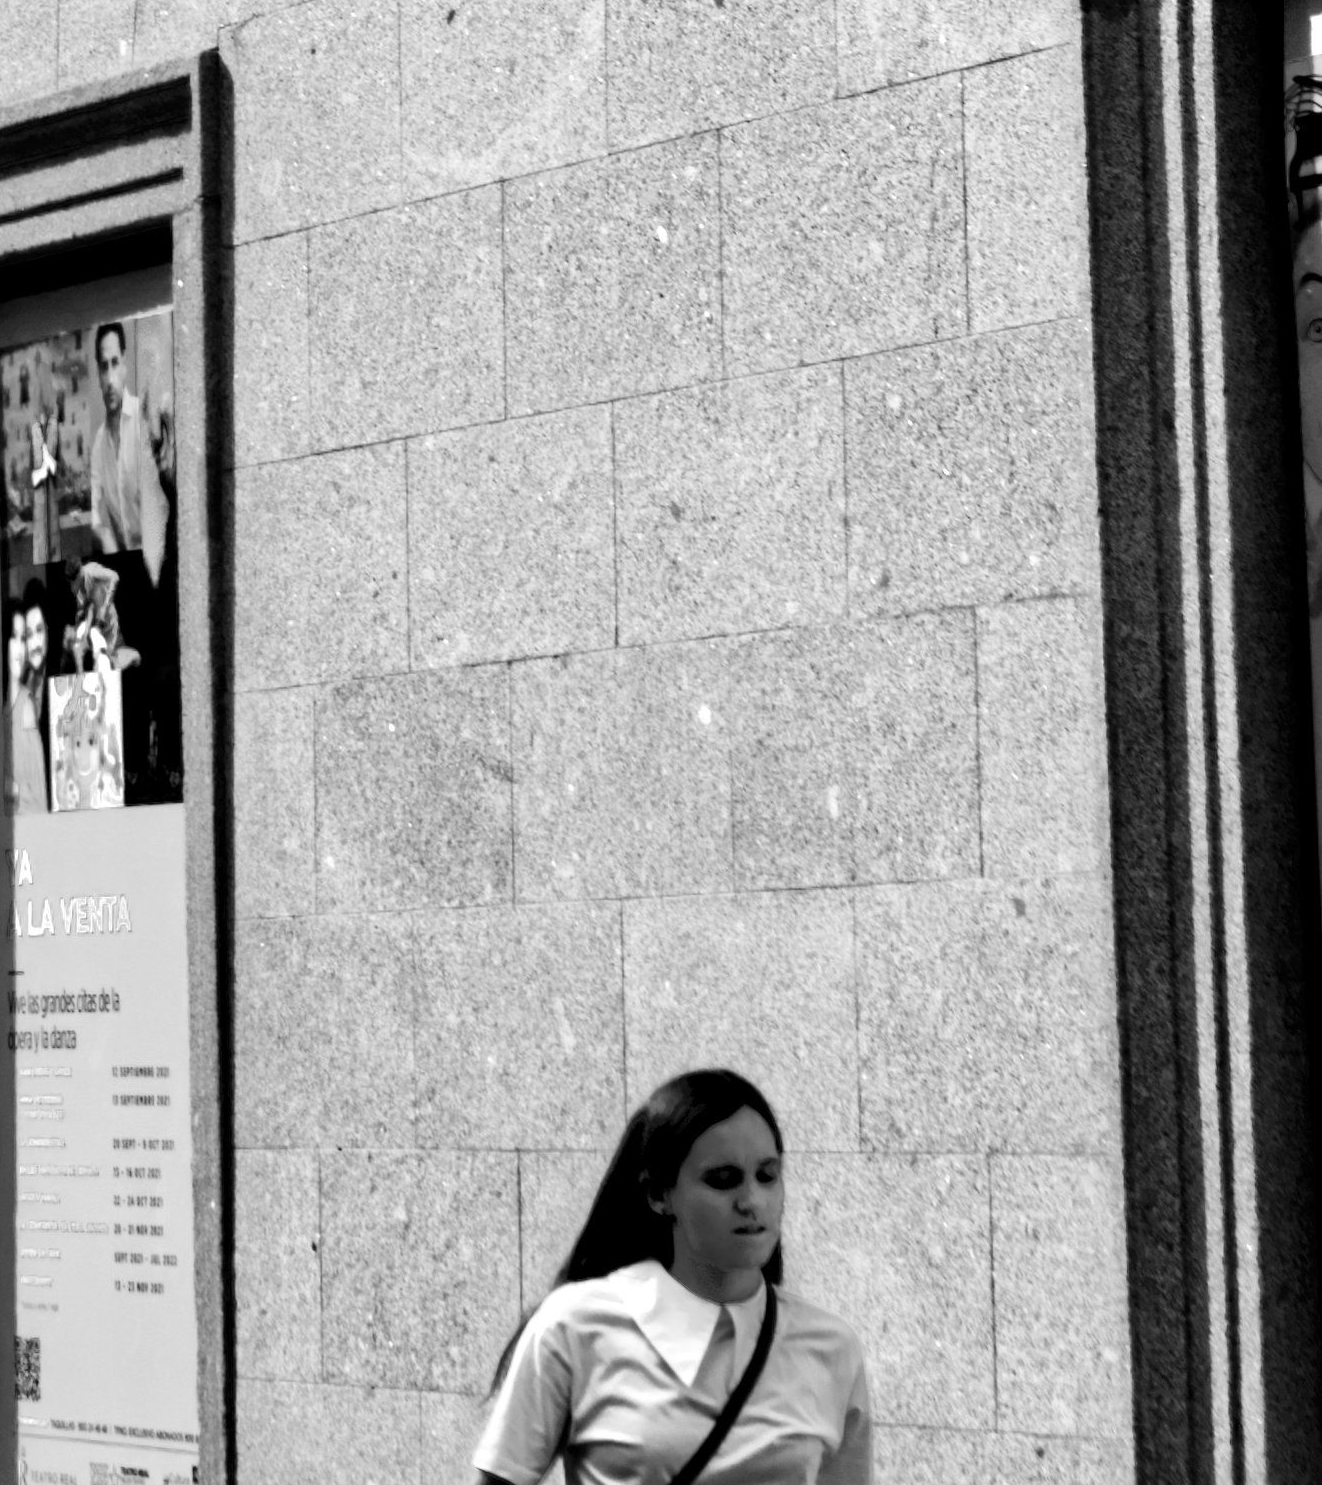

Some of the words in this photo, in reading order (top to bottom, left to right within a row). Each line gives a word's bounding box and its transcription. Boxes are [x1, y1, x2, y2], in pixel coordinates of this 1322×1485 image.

[4, 847, 35, 888] YA
[27, 897, 56, 939] LA
[59, 893, 133, 936] VENTA
[27, 990, 39, 1014] las
[41, 989, 75, 1019] grandes
[76, 989, 97, 1014] citas
[98, 988, 110, 1013] de
[112, 988, 121, 1013] la
[41, 1026, 49, 1050] la
[50, 1026, 77, 1050] danza
[119, 1065, 154, 1078] SEPTIEMBRE
[120, 1094, 155, 1106] SEPTIEMBRE
[148, 1138, 160, 1150] OCT
[134, 1166, 145, 1179] OCT
[136, 1195, 148, 1207] OCT
[136, 1223, 148, 1236] NOV
[136, 1281, 148, 1294] NOV
[31, 1470, 58, 1485] TEATRO
